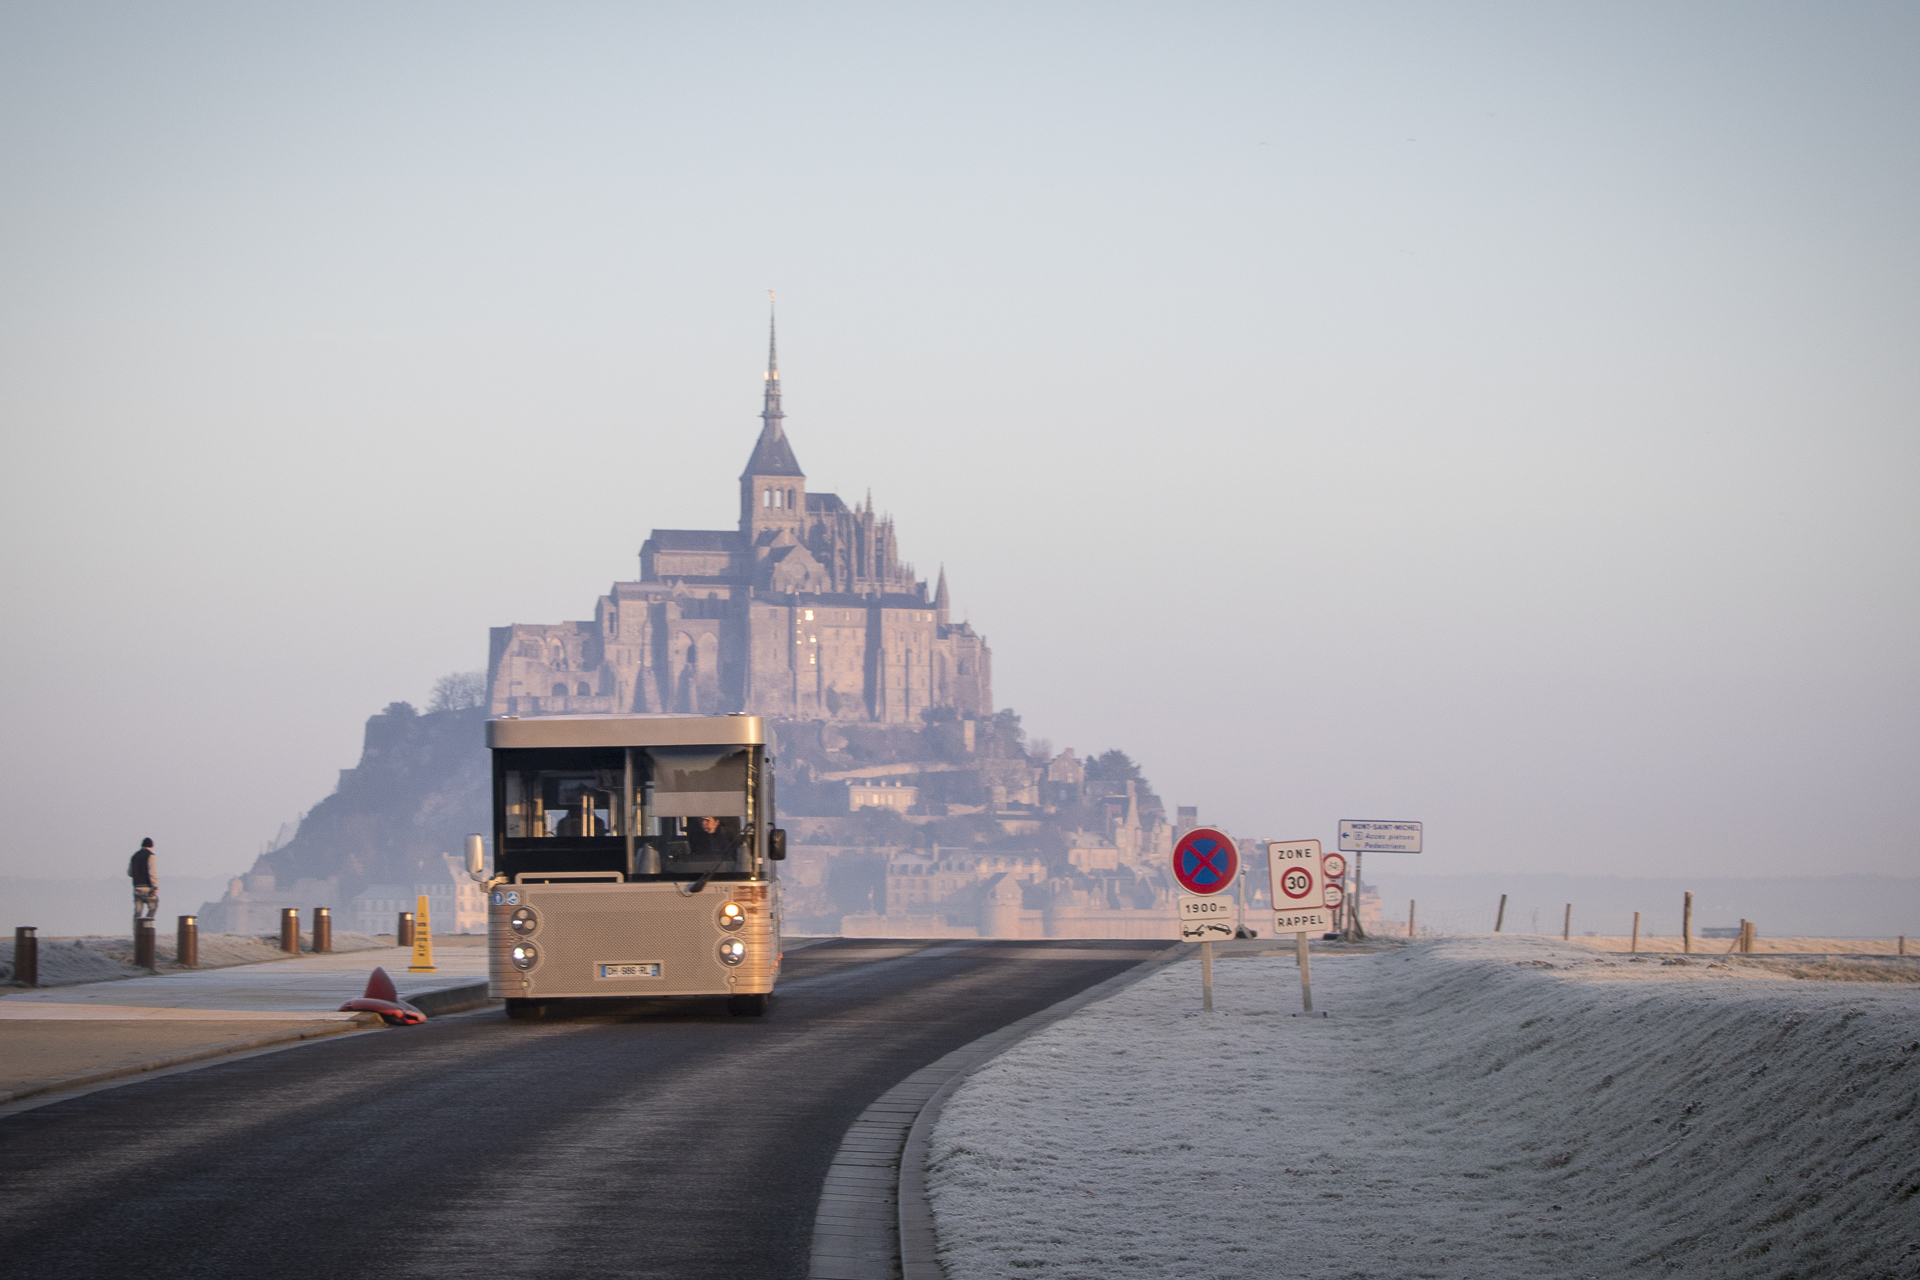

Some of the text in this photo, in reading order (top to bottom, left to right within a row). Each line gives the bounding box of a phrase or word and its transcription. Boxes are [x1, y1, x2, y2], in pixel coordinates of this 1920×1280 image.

[1278, 848, 1312, 860] ZONE
[1287, 876, 1307, 890] 30
[1185, 902, 1217, 913] 1900
[1278, 915, 1324, 927] RAPPEL
